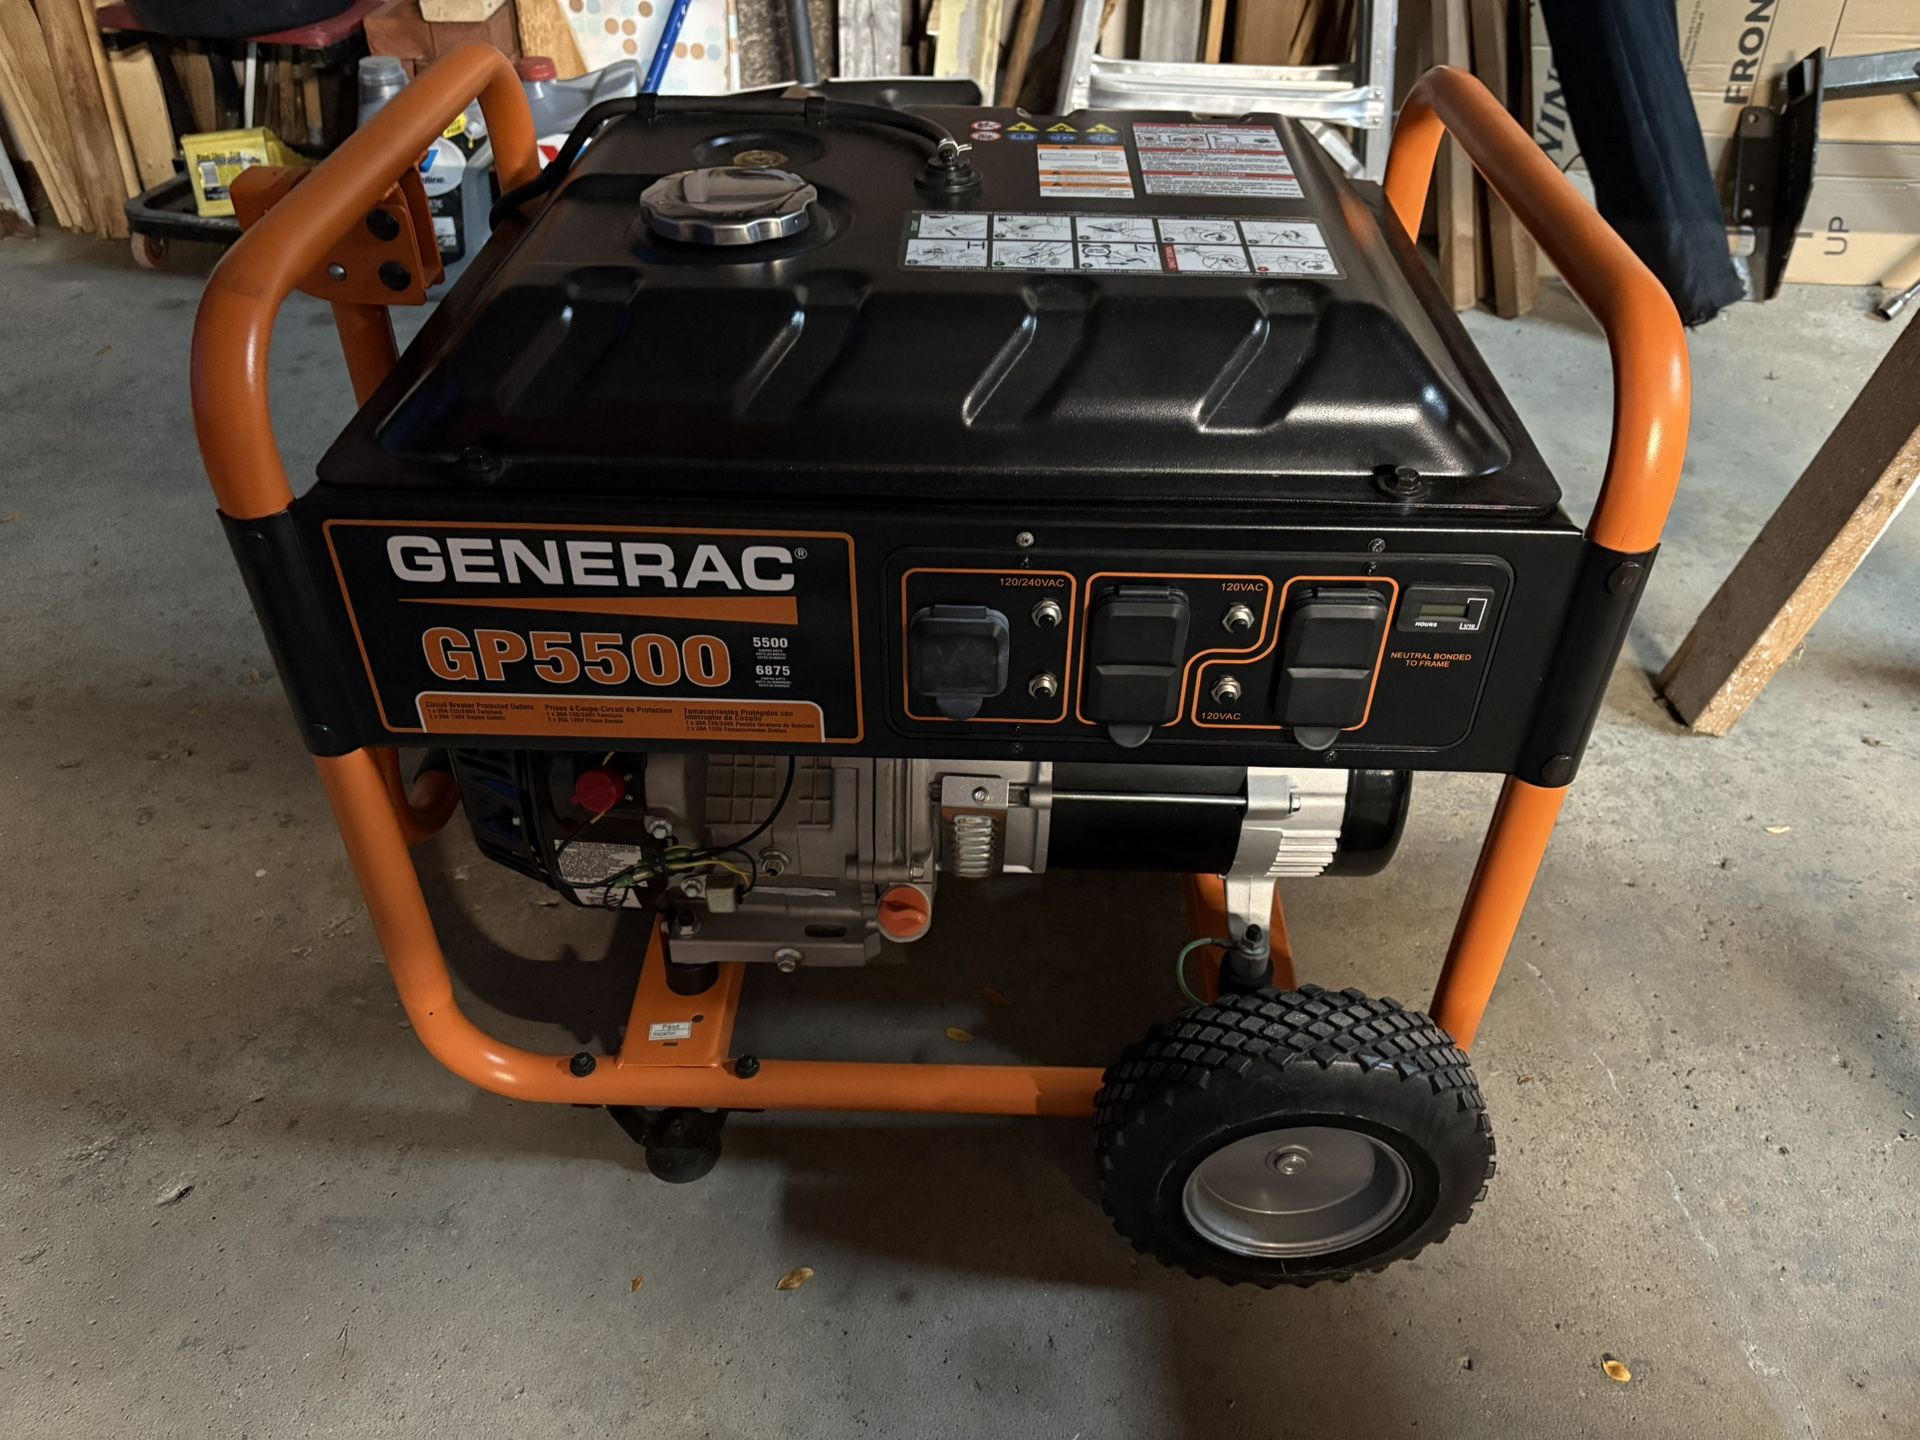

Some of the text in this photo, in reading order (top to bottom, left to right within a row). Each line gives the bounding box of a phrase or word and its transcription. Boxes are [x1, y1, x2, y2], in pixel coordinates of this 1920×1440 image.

[1823, 216, 1850, 256] UP
[386, 535, 796, 592] GENERAC
[999, 577, 1065, 588] 120/240VAC
[1220, 582, 1264, 593] 120VAC
[752, 636, 789, 648] 5500
[421, 626, 732, 688] GP5500
[1390, 652, 1472, 661] NEUTRAL BONDED
[755, 664, 791, 676] 6875
[425, 701, 447, 709] Circuit
[510, 703, 535, 711] Outlets
[1201, 711, 1242, 720] 120VAC
